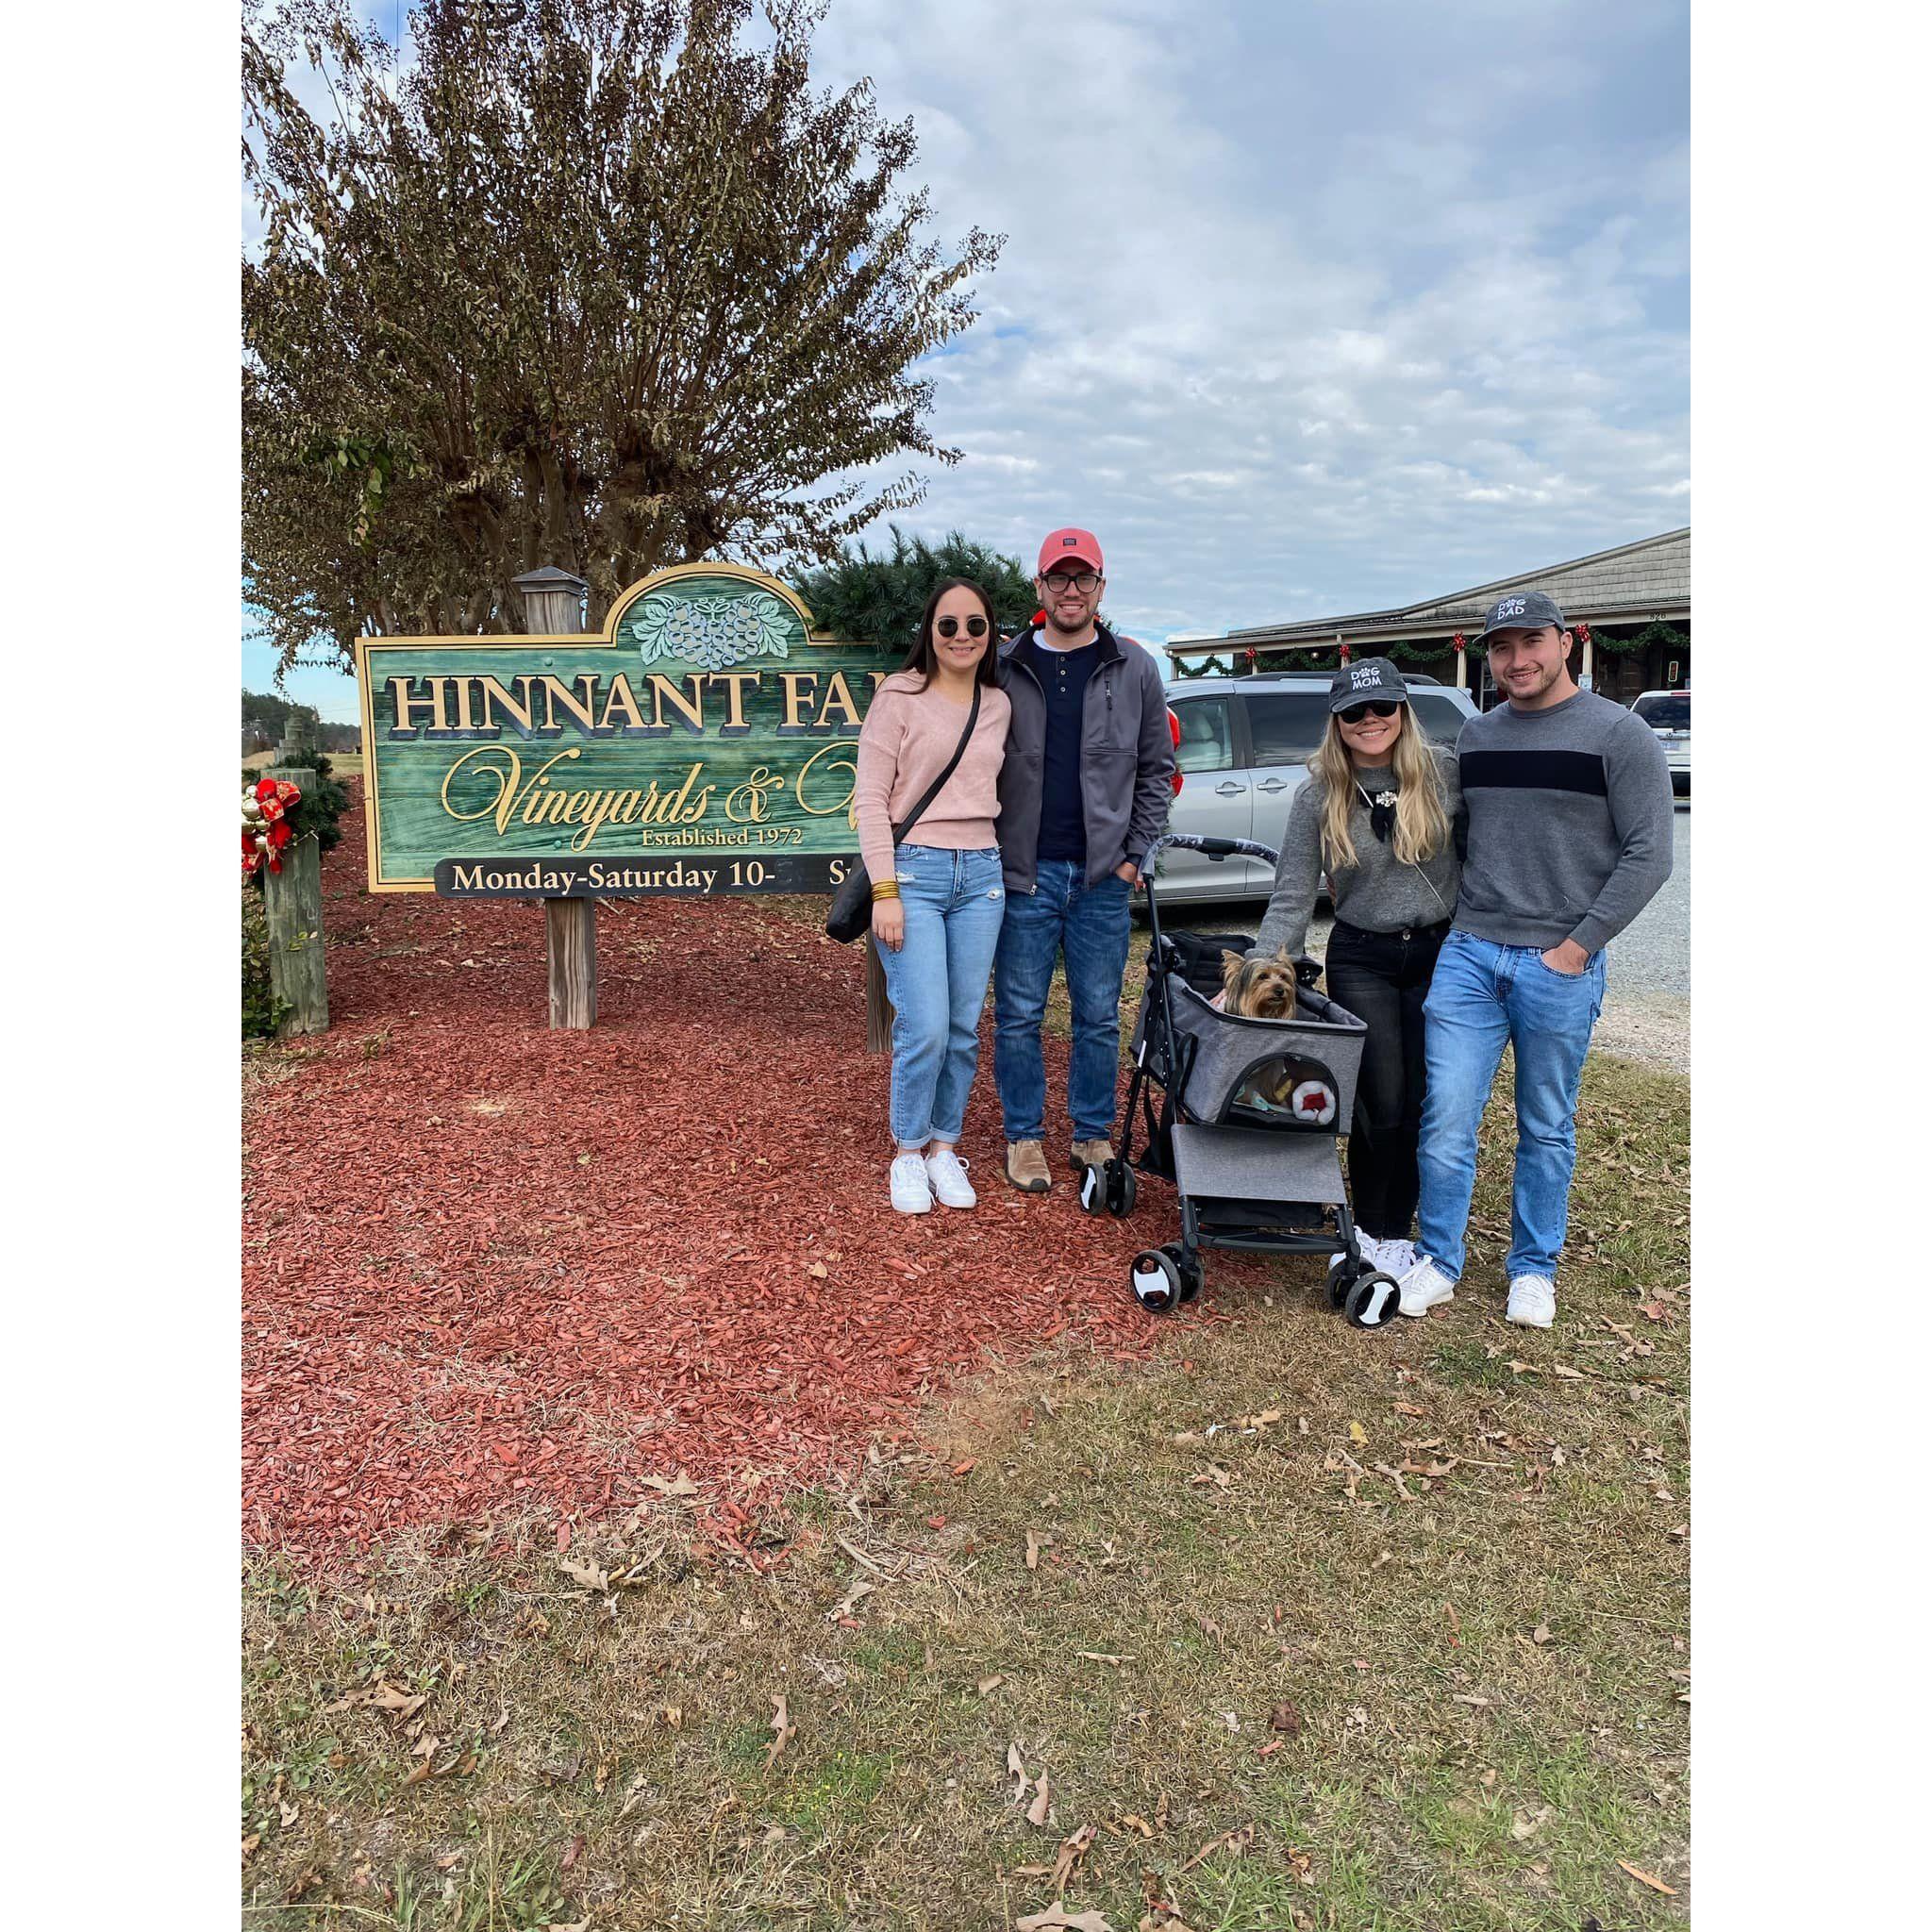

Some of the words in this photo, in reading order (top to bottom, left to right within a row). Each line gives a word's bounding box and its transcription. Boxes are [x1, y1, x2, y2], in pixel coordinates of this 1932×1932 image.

[1497, 606, 1525, 620] DAD
[1352, 675, 1383, 691] MOM
[386, 671, 761, 736] HINNANT
[441, 745, 717, 852] Vineyards
[724, 766, 785, 823] &
[641, 829, 749, 846] Established
[756, 828, 802, 845] 1972
[451, 859, 719, 895] Monday-Saturday
